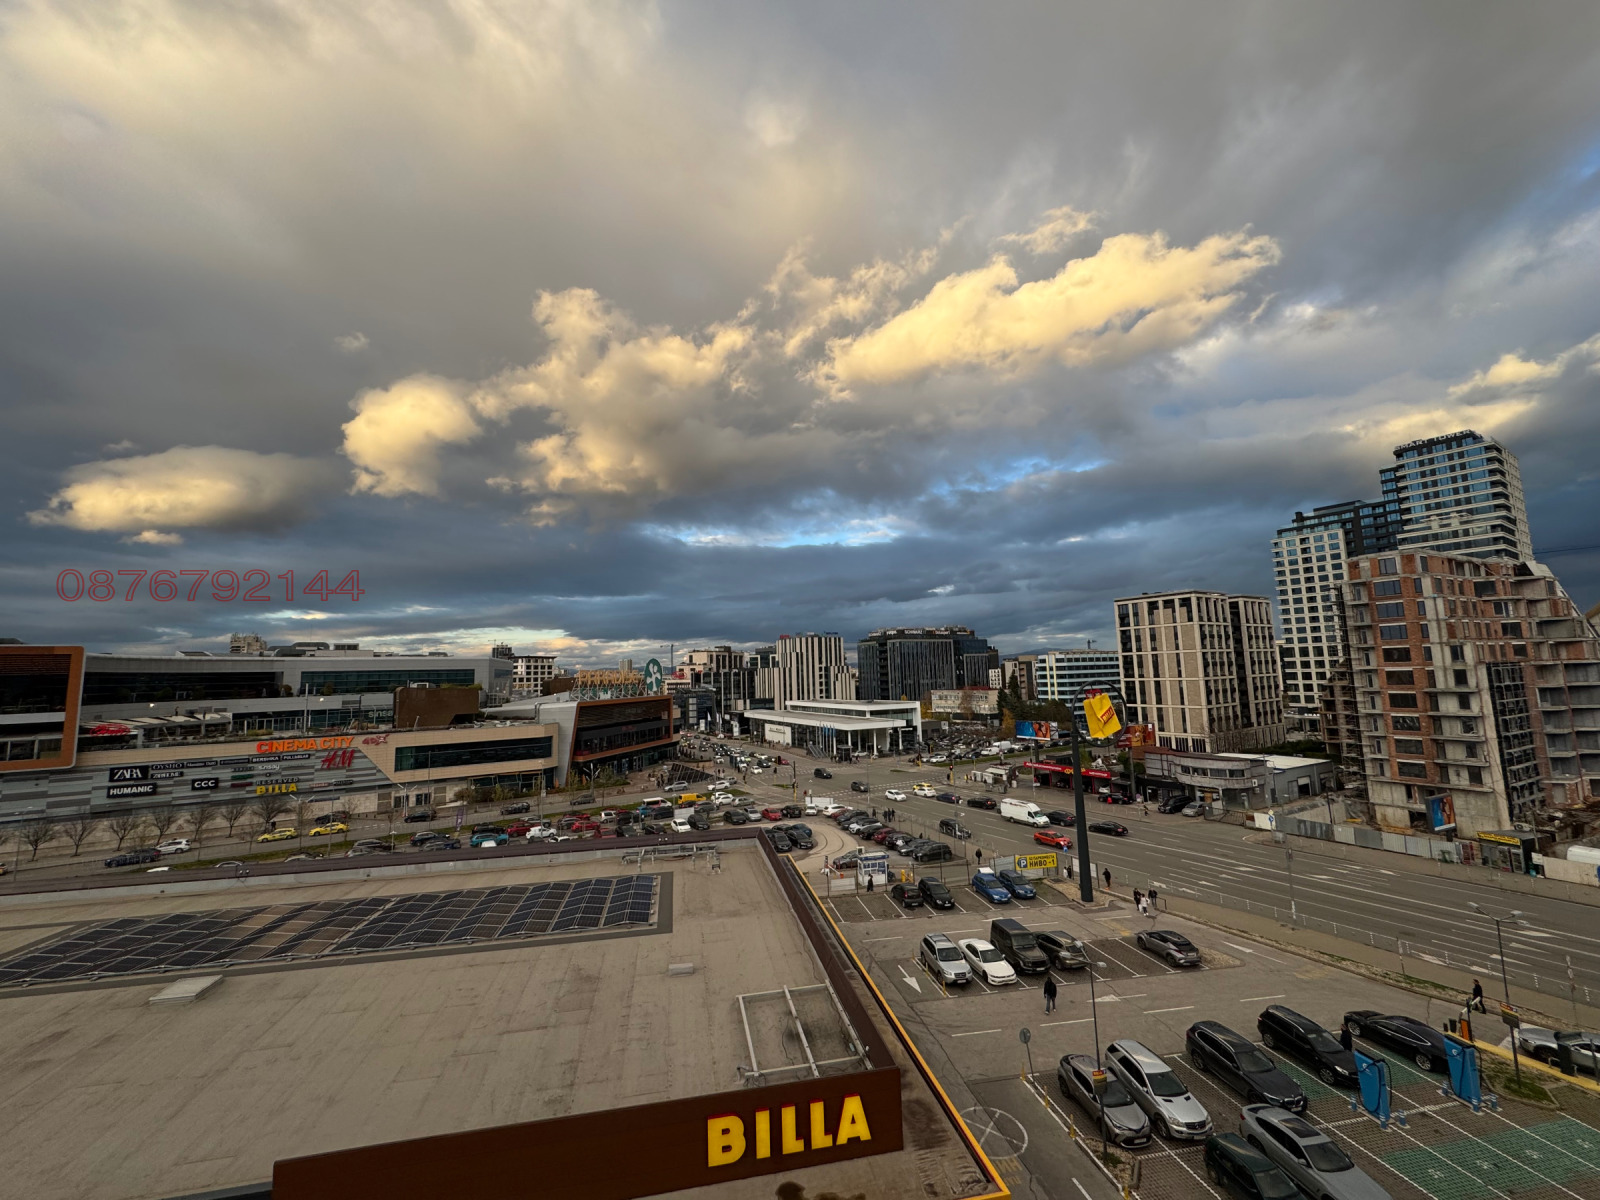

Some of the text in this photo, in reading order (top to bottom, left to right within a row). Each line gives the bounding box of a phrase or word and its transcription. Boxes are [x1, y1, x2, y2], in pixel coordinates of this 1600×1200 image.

[1394, 429, 1471, 451] SMART TOWER
[578, 669, 639, 685] PARADISE
[256, 736, 355, 753] CINEMA CITY
[114, 768, 143, 779] ZARA
[110, 785, 154, 795] HUMANIC
[194, 780, 216, 788] CCC
[256, 783, 297, 795] BILLA
[1029, 859, 1047, 867] НИВО
[707, 1093, 872, 1168] BILLA
